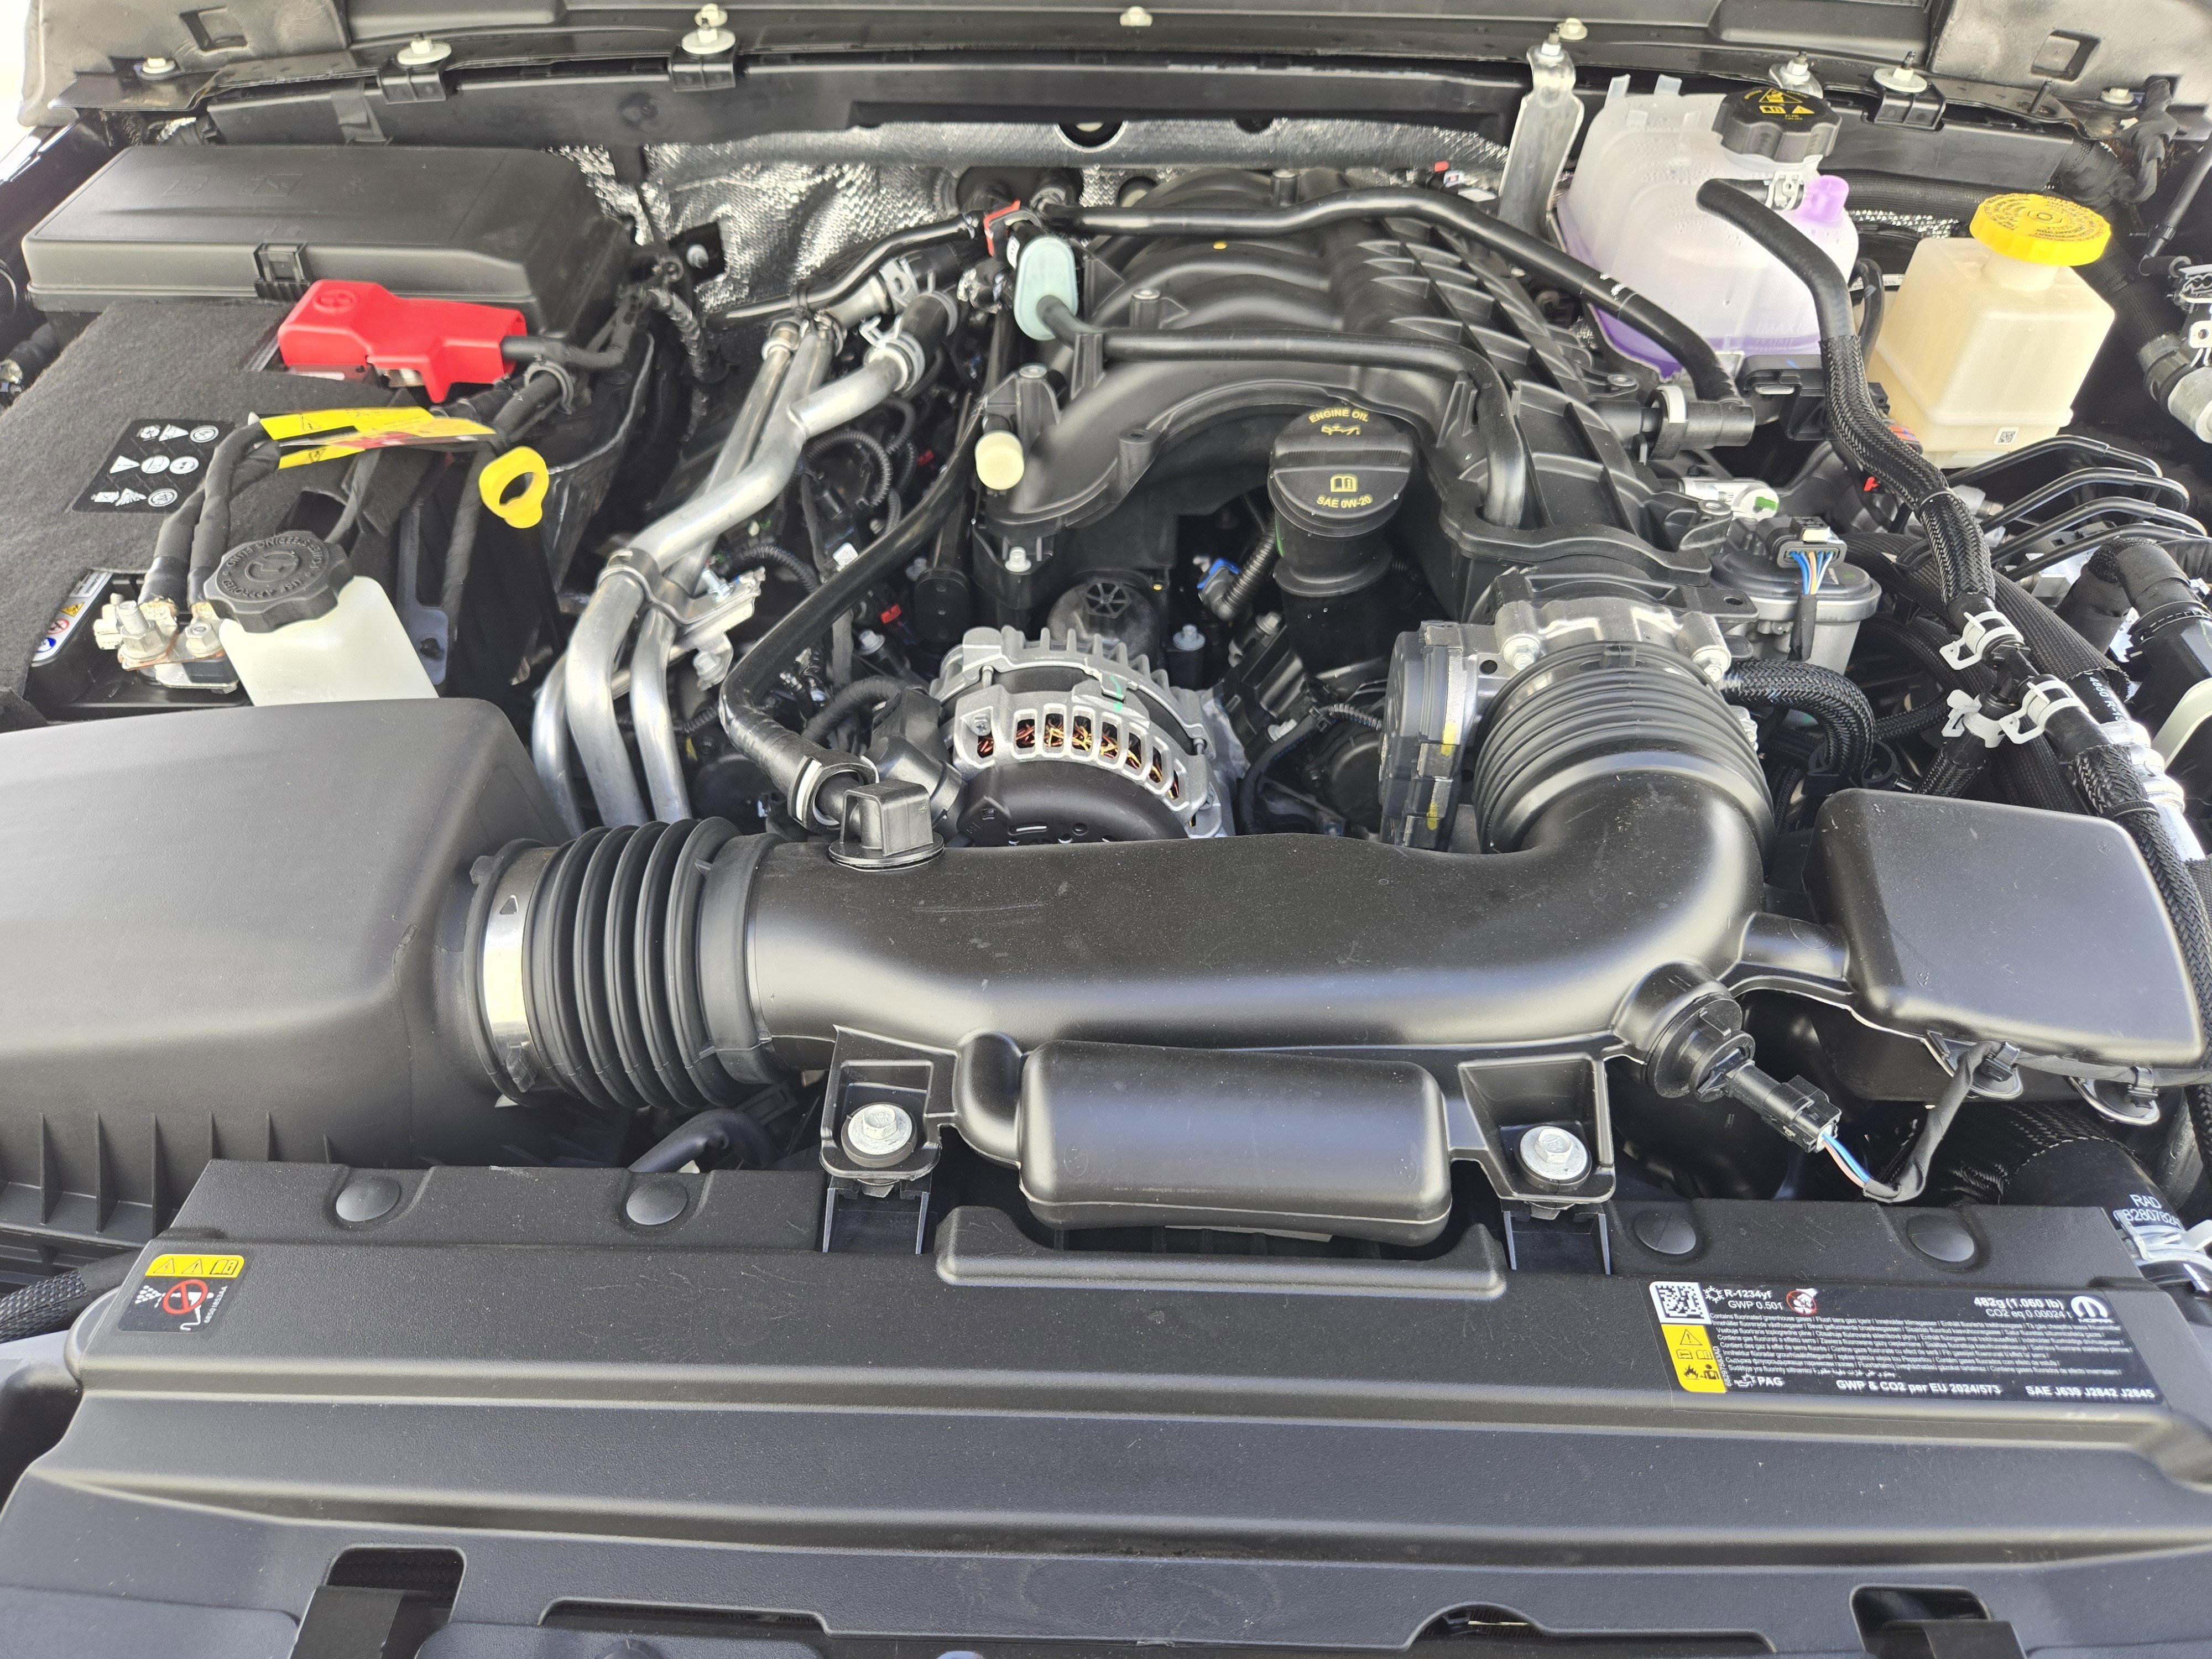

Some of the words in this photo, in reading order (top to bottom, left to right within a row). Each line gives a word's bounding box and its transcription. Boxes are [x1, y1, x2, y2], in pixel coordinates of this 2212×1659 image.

[1309, 408, 1349, 423] ENGINE
[1351, 409, 1369, 422] OIL
[1316, 495, 1339, 508] SAE
[1340, 494, 1373, 508] 0W-20
[2129, 1194, 2162, 1209] RAD
[1724, 1289, 1772, 1300] R-1234yf
[1728, 1300, 1754, 1310] GWP
[1757, 1301, 1783, 1311] 0.501
[1973, 1297, 2007, 1310] 482g
[2006, 1297, 2044, 1310] (1.060
[2046, 1298, 2065, 1311] lb)
[1985, 1309, 2008, 1317] CO2
[2011, 1311, 2026, 1321] eq
[2026, 1310, 2066, 1319] 0.00024
[1757, 1376, 1785, 1387] PAG
[1836, 1379, 1866, 1391] GWP
[1867, 1380, 1879, 1391] &
[1880, 1380, 1907, 1392] CO2
[1907, 1383, 1928, 1395] per
[1929, 1383, 1948, 1394] EU
[1949, 1383, 2002, 1395] 2024/573
[2025, 1385, 2053, 1397] SAE
[2054, 1386, 2082, 1397] J639
[2084, 1387, 2119, 1399] J2842
[2120, 1387, 2156, 1399] J2845
